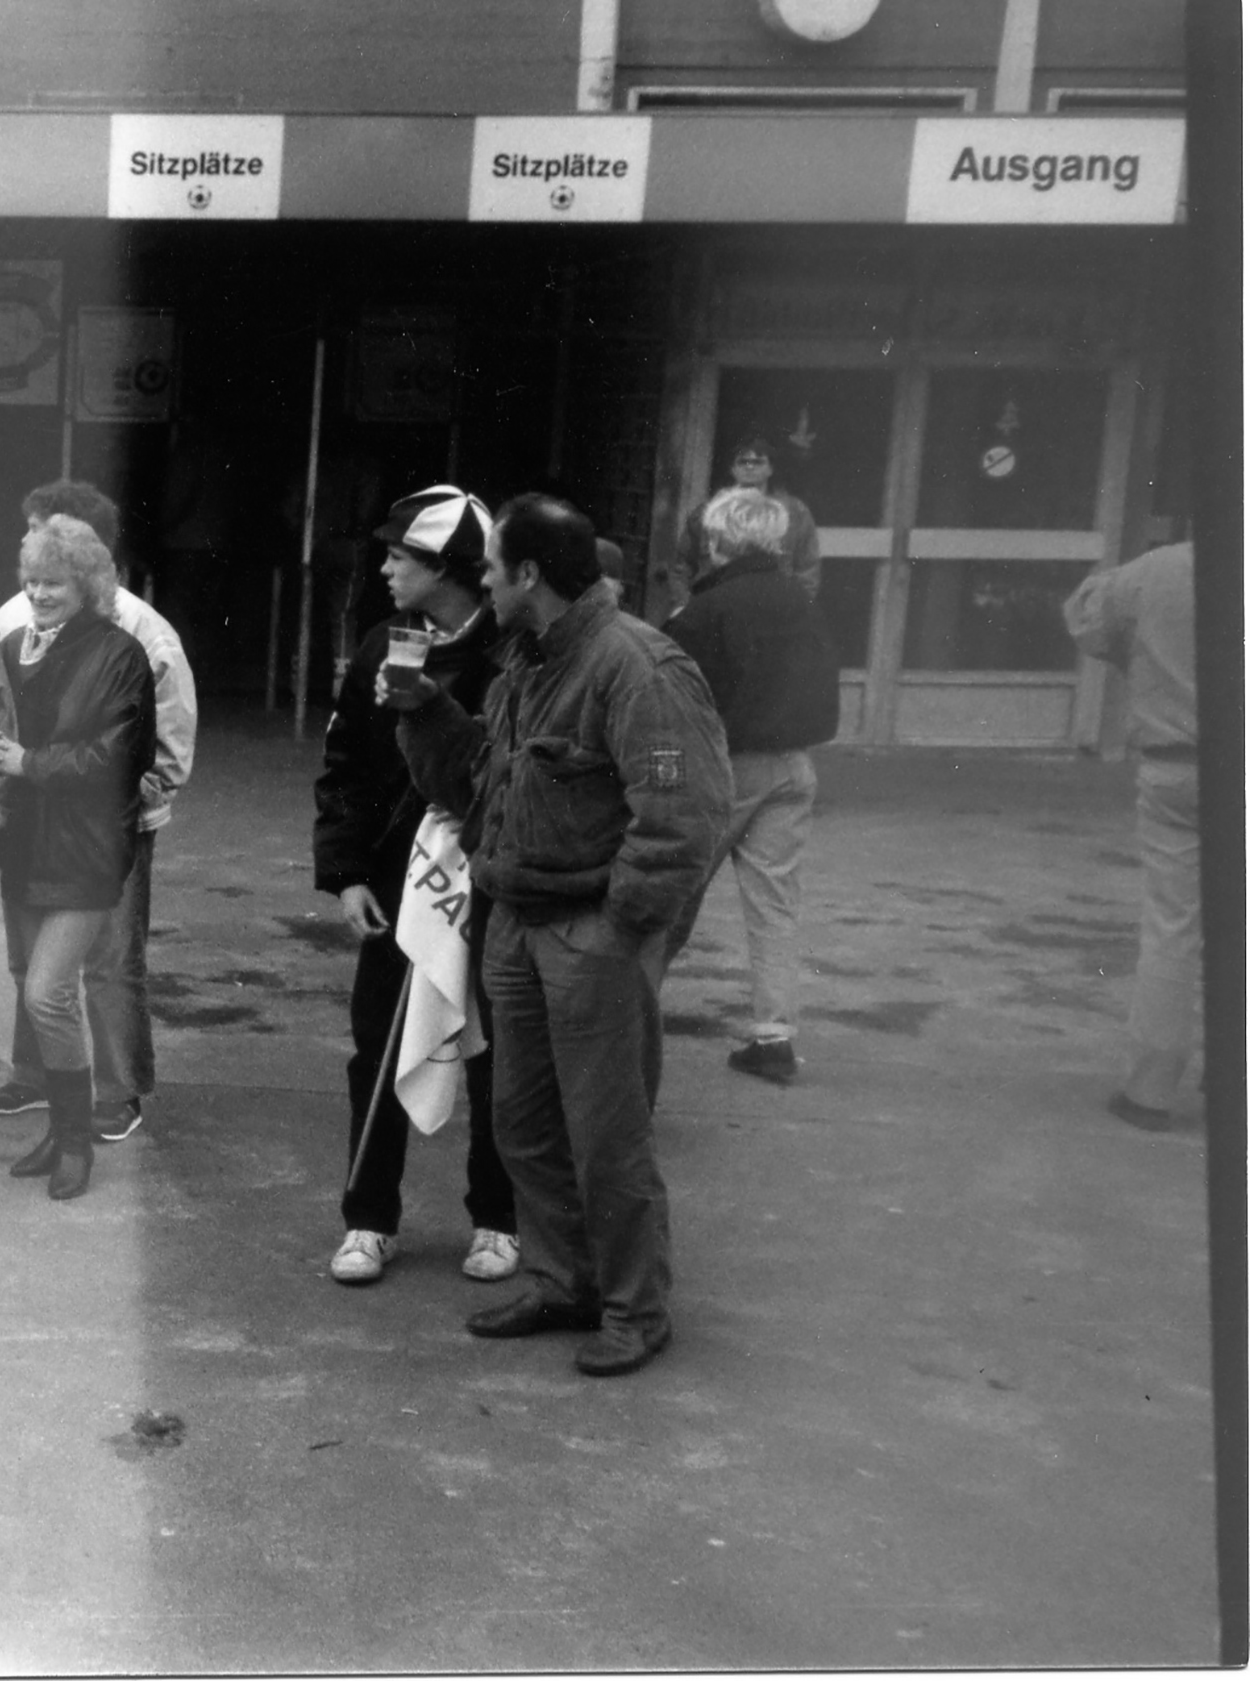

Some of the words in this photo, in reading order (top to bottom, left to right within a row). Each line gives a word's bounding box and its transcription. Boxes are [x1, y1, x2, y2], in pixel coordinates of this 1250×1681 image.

[130, 151, 263, 181] Sitzplätze
[492, 153, 628, 182] Sitzplätze
[949, 146, 1140, 192] Ausgang
